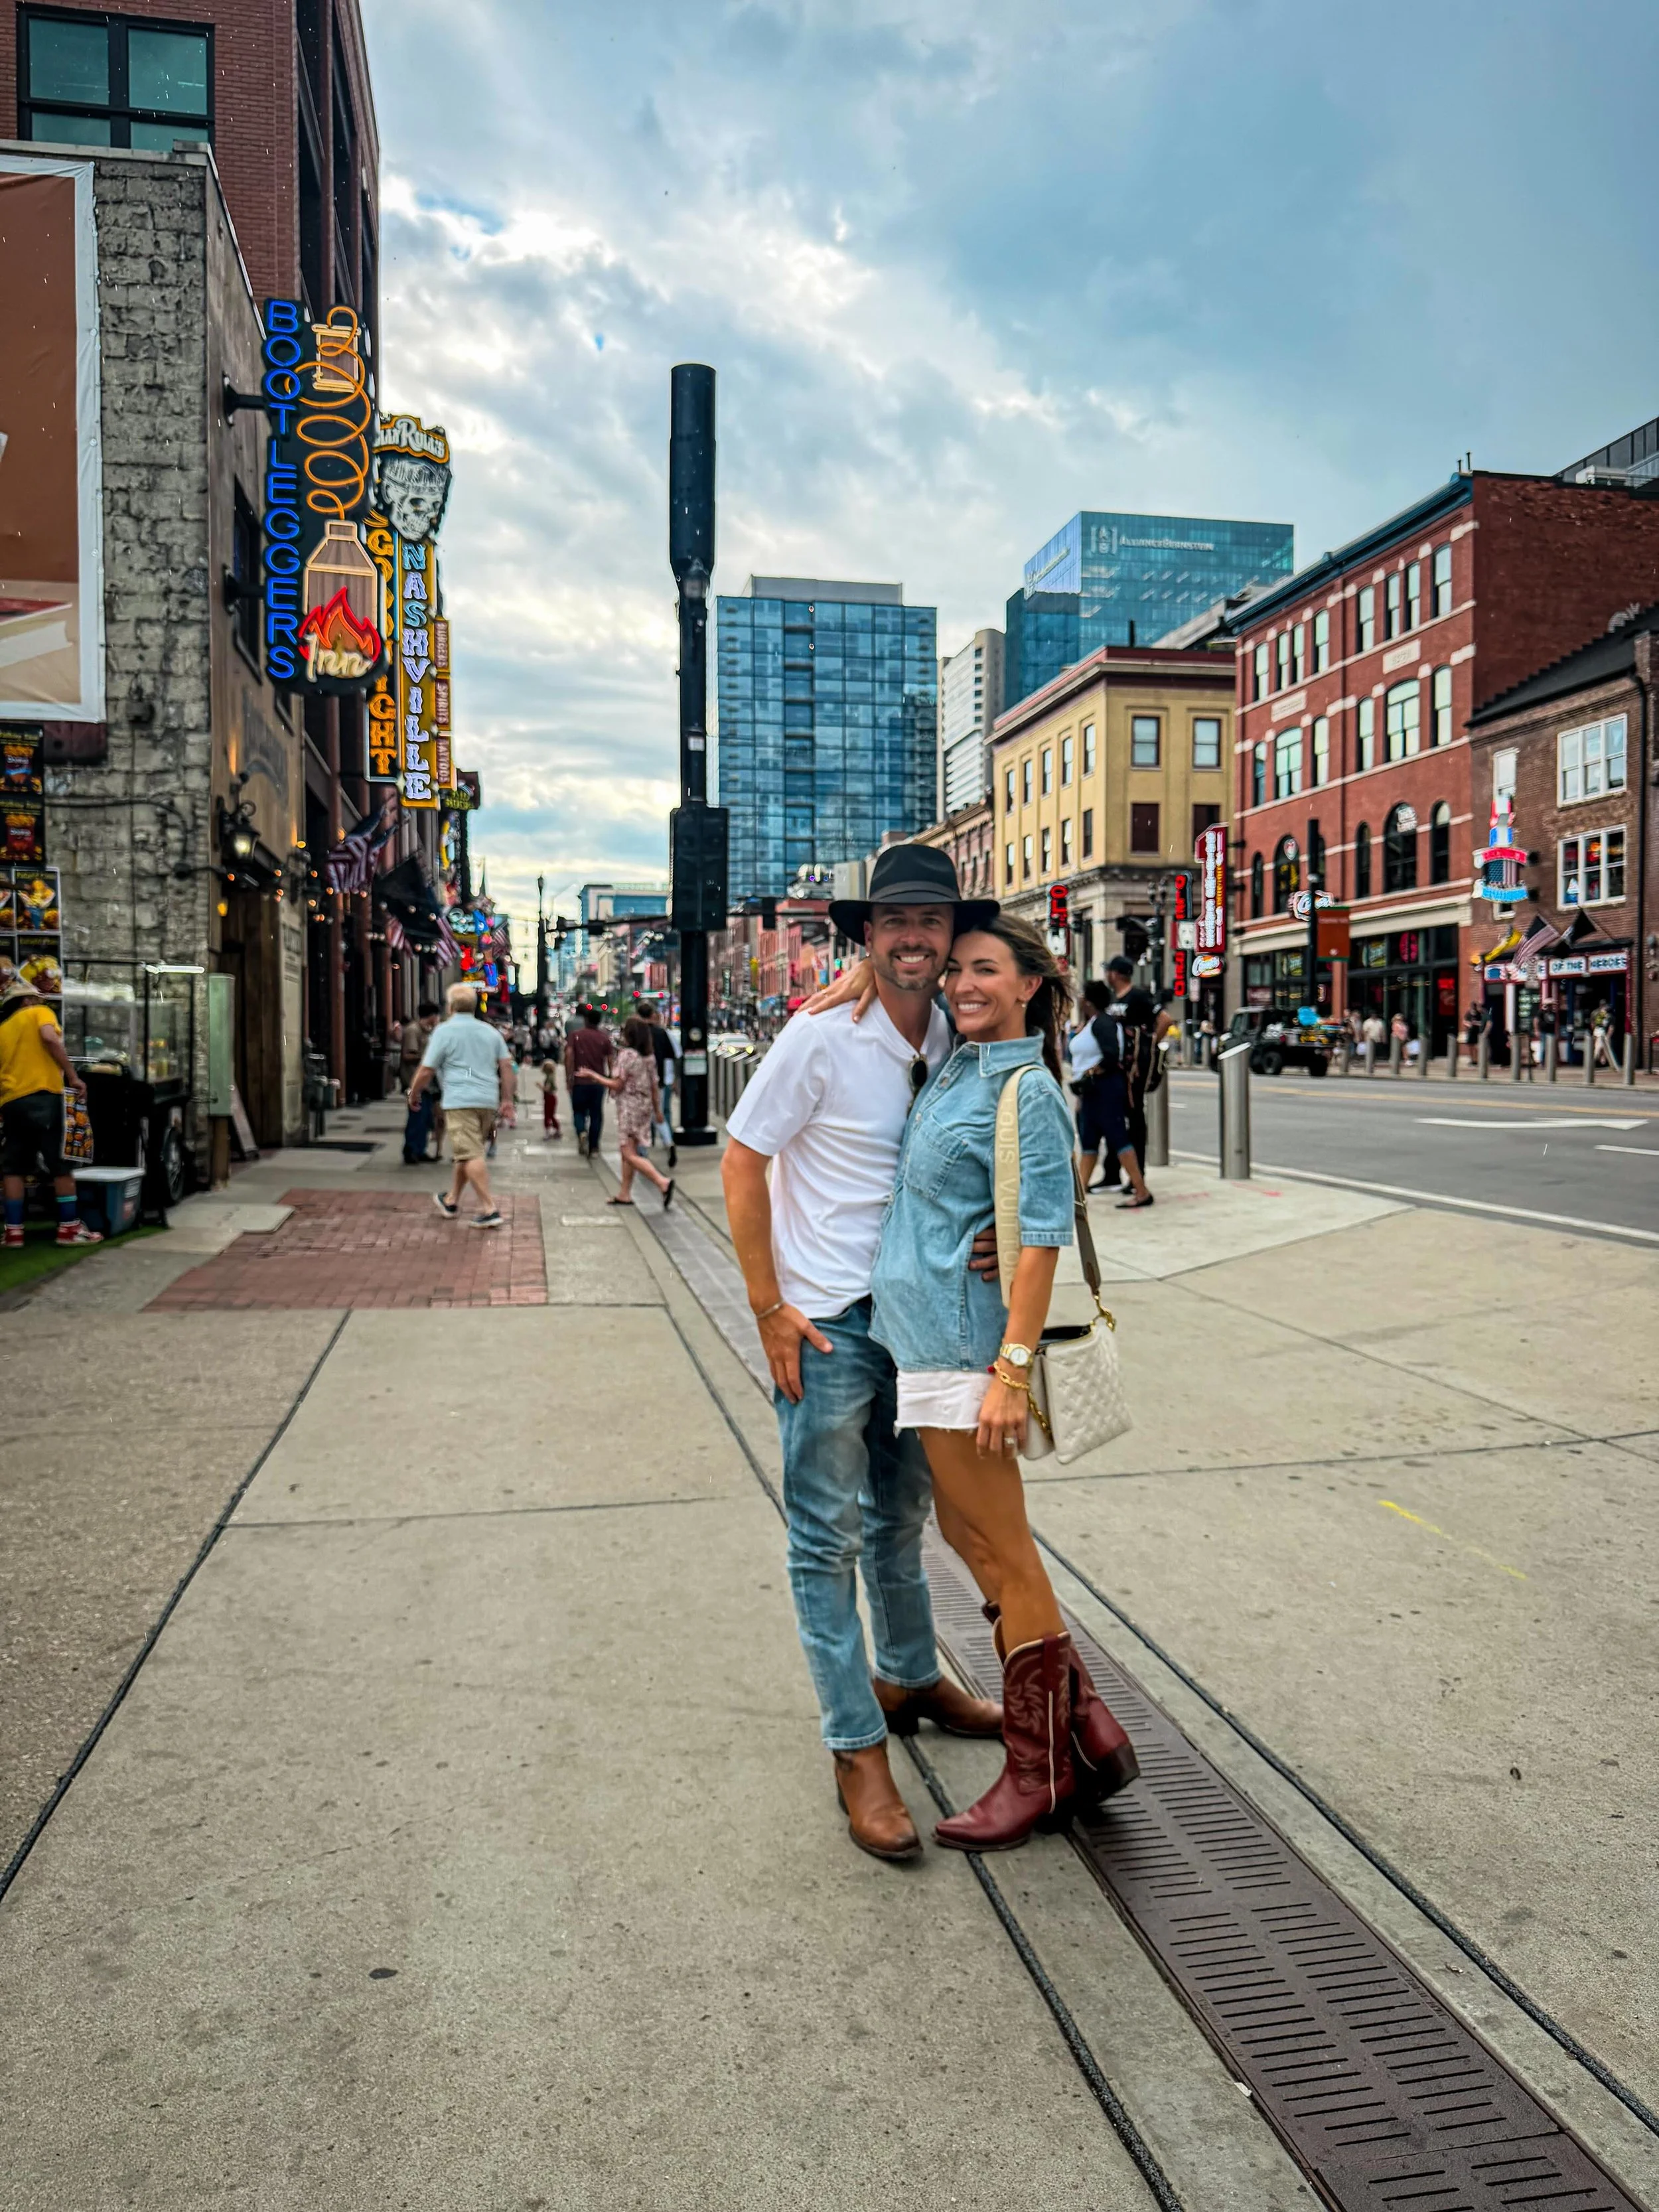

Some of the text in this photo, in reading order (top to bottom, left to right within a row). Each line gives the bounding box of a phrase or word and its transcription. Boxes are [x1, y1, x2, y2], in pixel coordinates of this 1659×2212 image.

[265, 301, 301, 678] BOOTLEGGERS
[303, 632, 374, 683] Inn
[402, 543, 432, 800] NASHVILLE
[999, 1098, 1015, 1164] LOUIS
